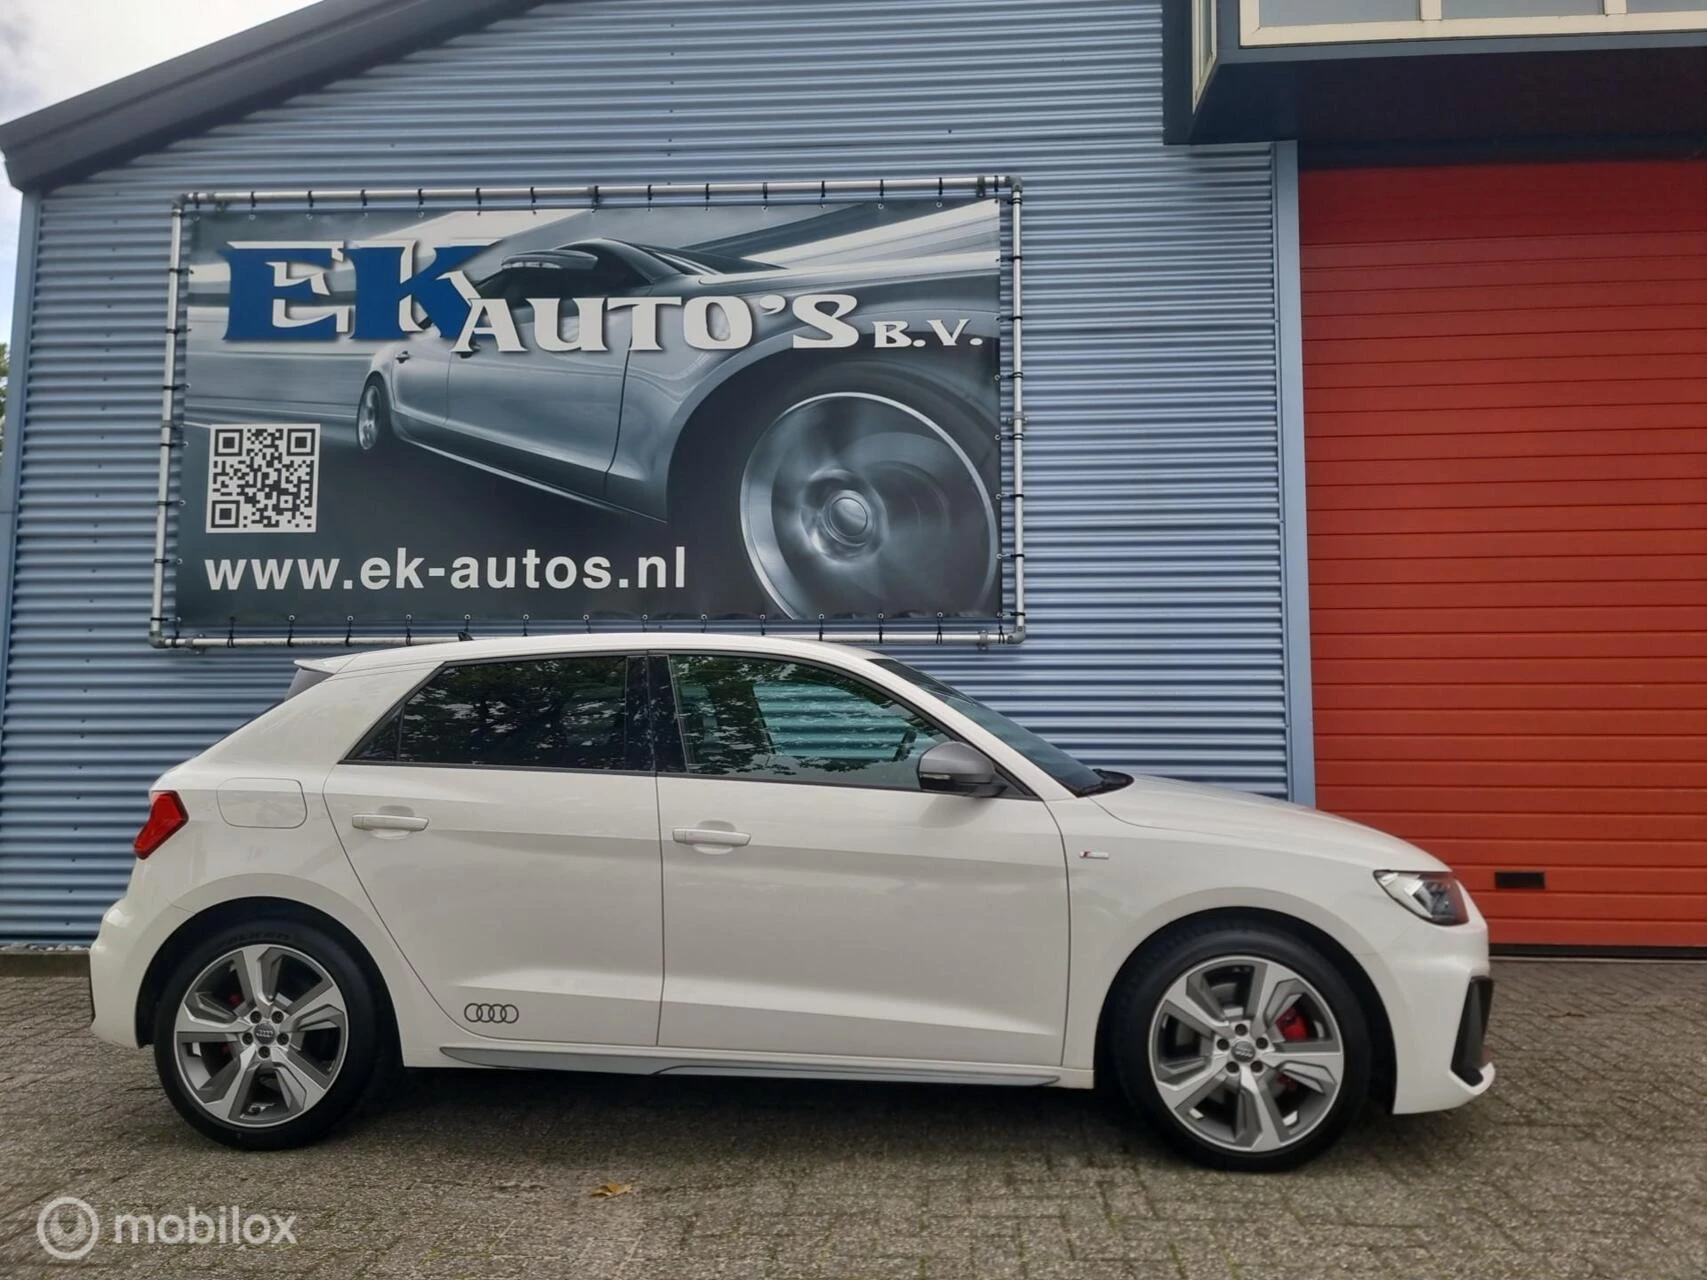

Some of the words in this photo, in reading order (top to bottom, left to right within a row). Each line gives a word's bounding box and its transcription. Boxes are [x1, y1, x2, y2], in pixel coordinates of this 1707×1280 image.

[219, 240, 503, 341] EK
[451, 293, 860, 353] AUTO'S
[873, 318, 984, 349] B.V.
[204, 546, 686, 591] www.ek-autos.nl
